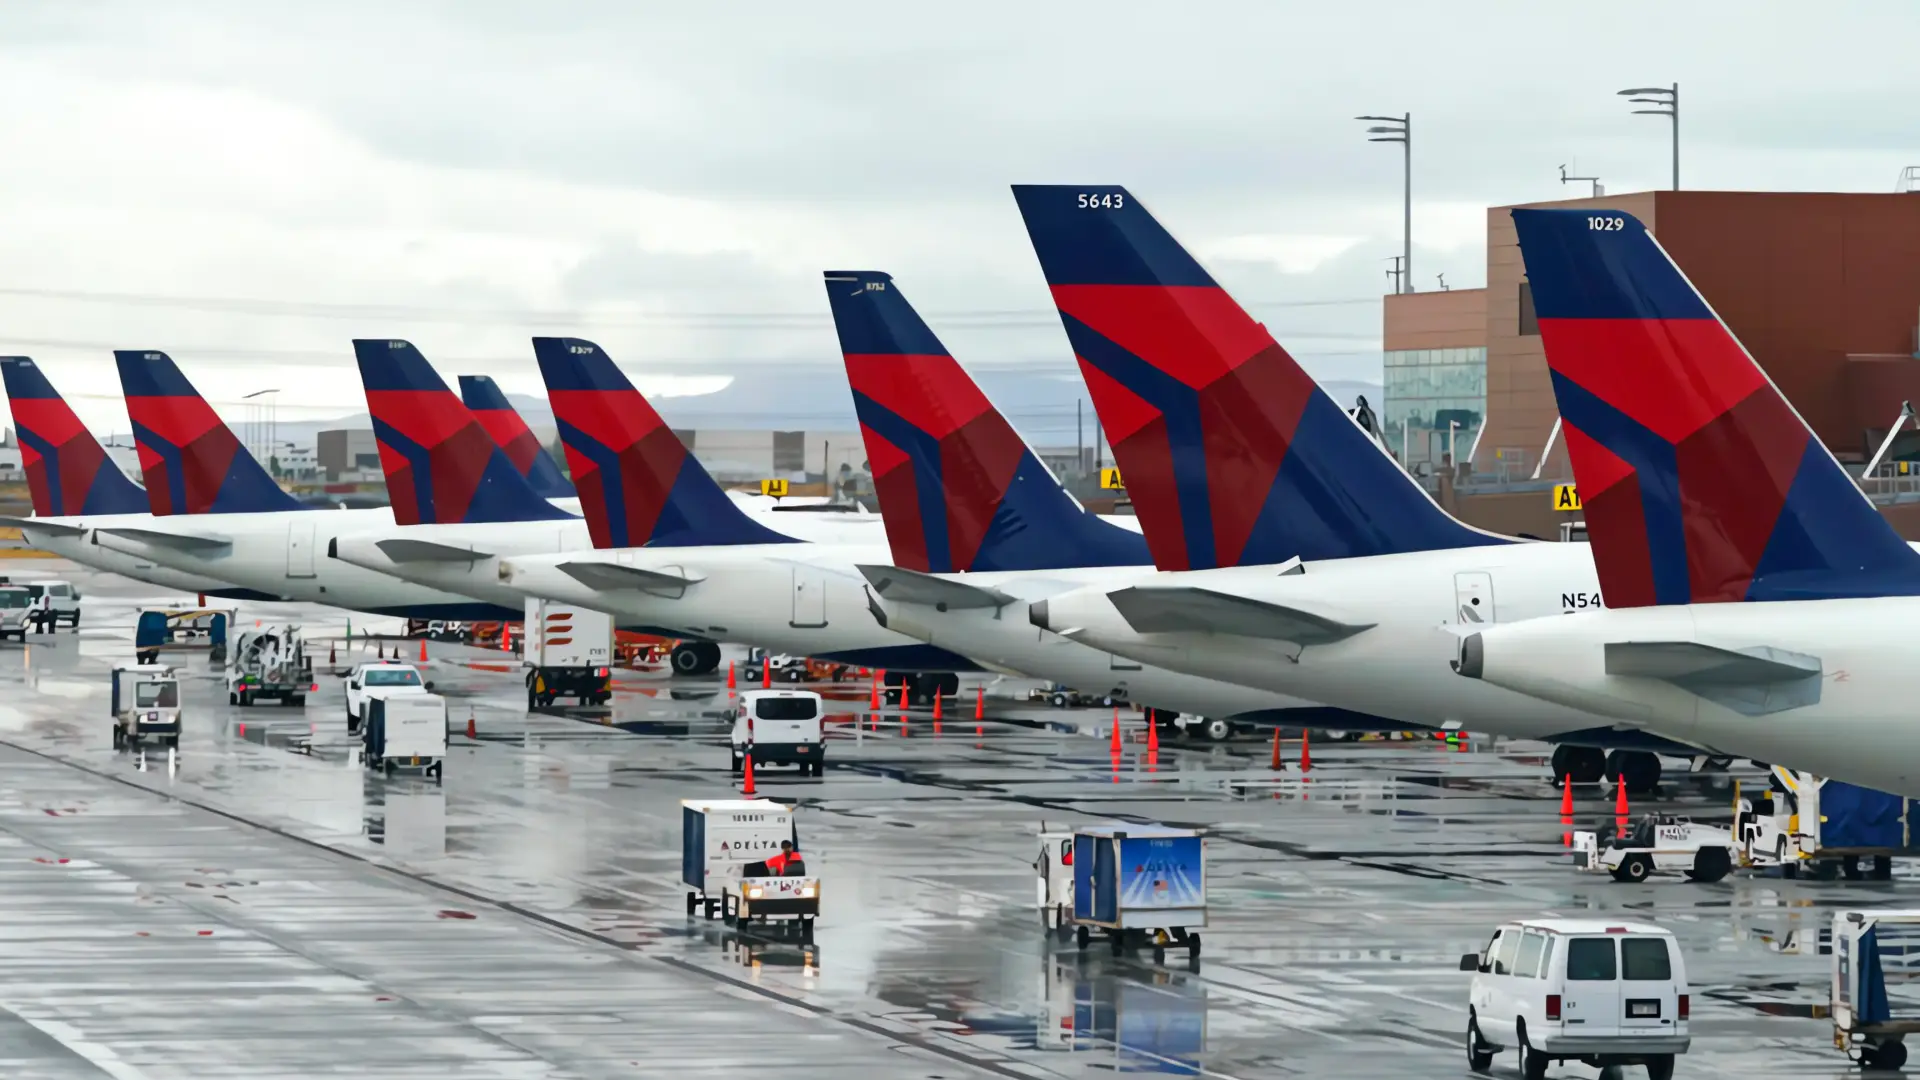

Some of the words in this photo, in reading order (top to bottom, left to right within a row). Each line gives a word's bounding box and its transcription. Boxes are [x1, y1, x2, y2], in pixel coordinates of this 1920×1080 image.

[1078, 193, 1123, 209] 5643
[1587, 216, 1625, 231] 1029
[1562, 593, 1601, 608] N54
[733, 841, 777, 850] DELTA
